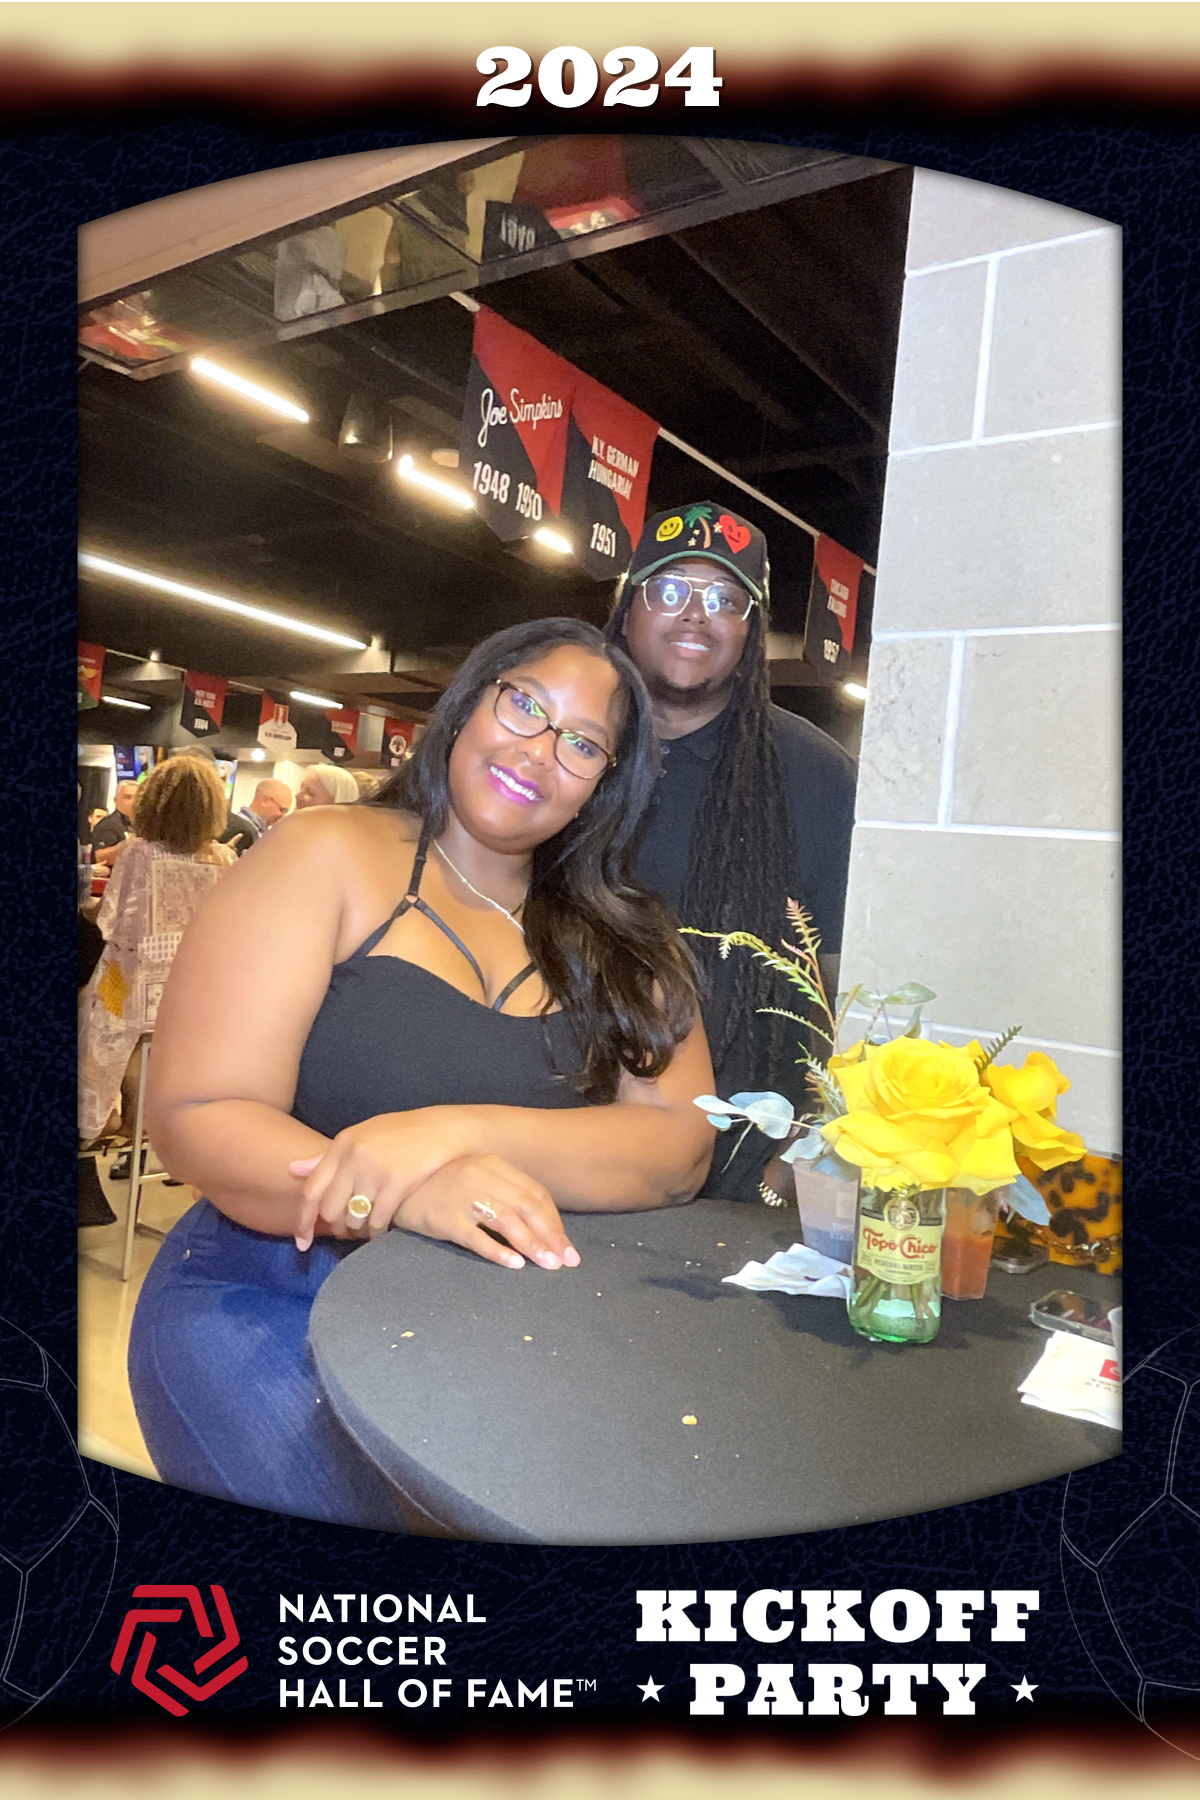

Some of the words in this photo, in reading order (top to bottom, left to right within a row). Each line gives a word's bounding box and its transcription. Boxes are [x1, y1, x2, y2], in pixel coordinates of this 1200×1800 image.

[478, 387, 508, 448] Joe
[509, 387, 563, 430] Simpkins
[606, 444, 640, 479] GERMAN
[473, 461, 511, 504] 1948
[515, 482, 542, 521] 1950
[590, 522, 616, 558] 1951
[863, 1227, 898, 1252] Topo
[899, 1236, 938, 1259] Chico
